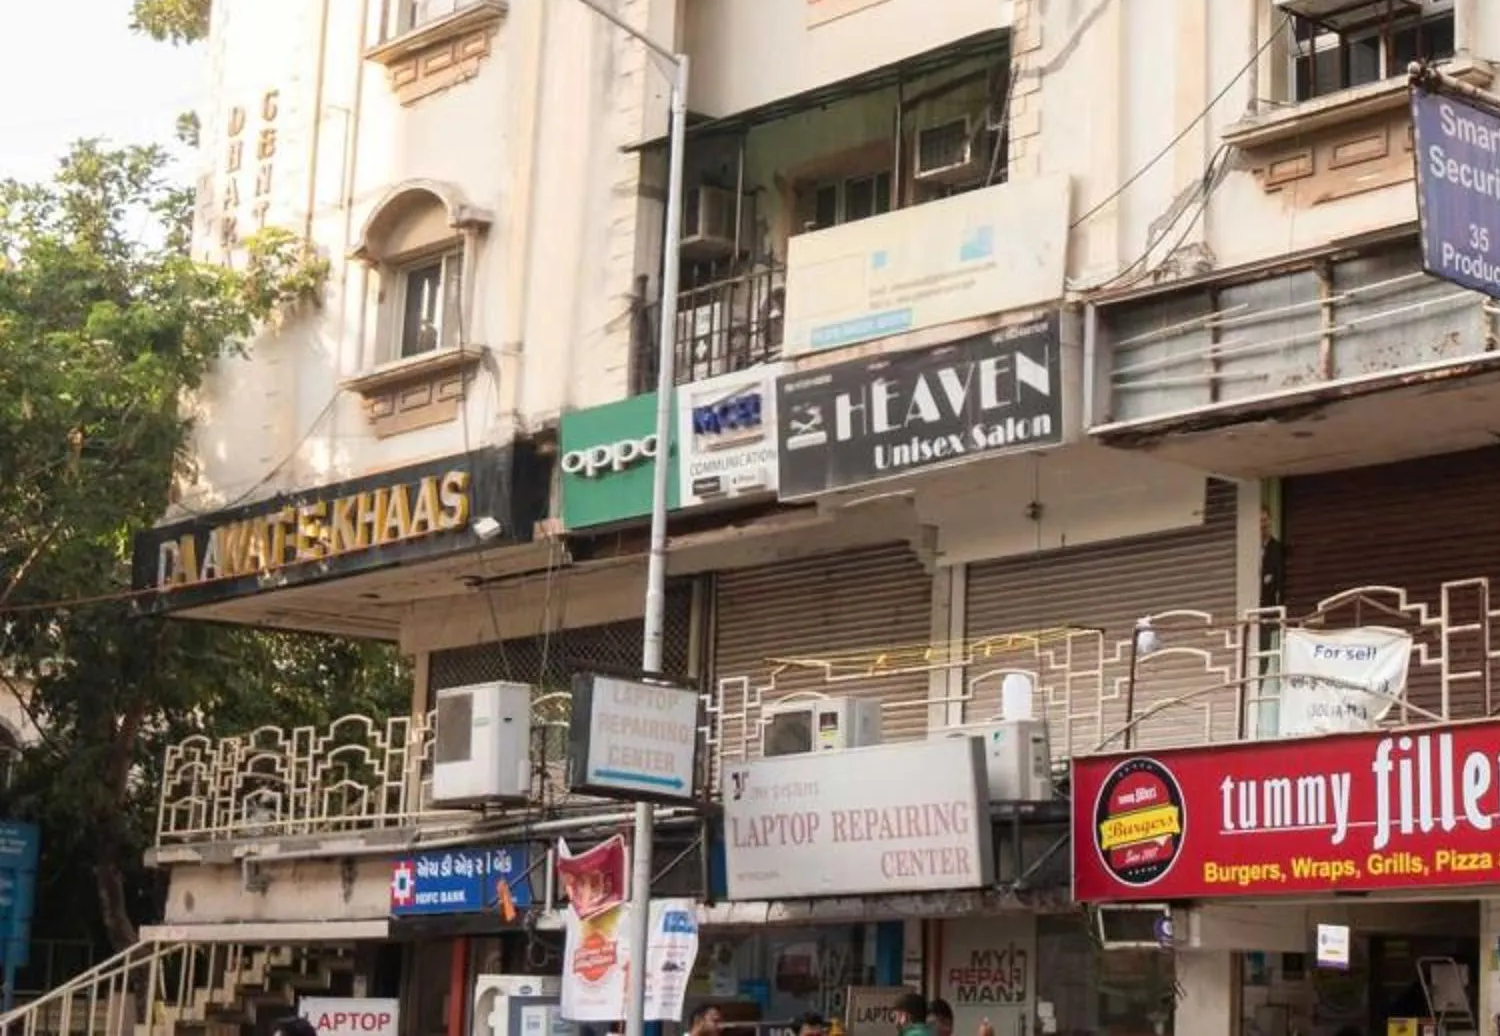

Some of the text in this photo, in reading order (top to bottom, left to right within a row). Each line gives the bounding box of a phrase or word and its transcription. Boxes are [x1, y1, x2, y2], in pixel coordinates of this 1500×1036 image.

[1468, 223, 1490, 252] 35
[836, 343, 1051, 441] HEAVEN
[874, 413, 1051, 469] Unisex Salon
[1313, 644, 1378, 661] For sell
[611, 683, 680, 711] LAPTOP
[597, 713, 690, 744] REPAIRING
[607, 746, 675, 773] CENTER
[1221, 772, 1351, 845] tummy
[732, 801, 969, 848] LAPTOP REPAIRING
[881, 847, 970, 879] CENTER
[1204, 862, 1287, 885] Burgers,
[1291, 857, 1361, 881] Wraps,
[1367, 852, 1430, 877] Grills,
[1435, 850, 1493, 871] Pizza
[440, 890, 466, 904] BANK
[971, 949, 1007, 968] MY
[958, 985, 1013, 1003] MAN
[305, 1010, 391, 1032] APTOP
[856, 1005, 905, 1023] LAPTO
